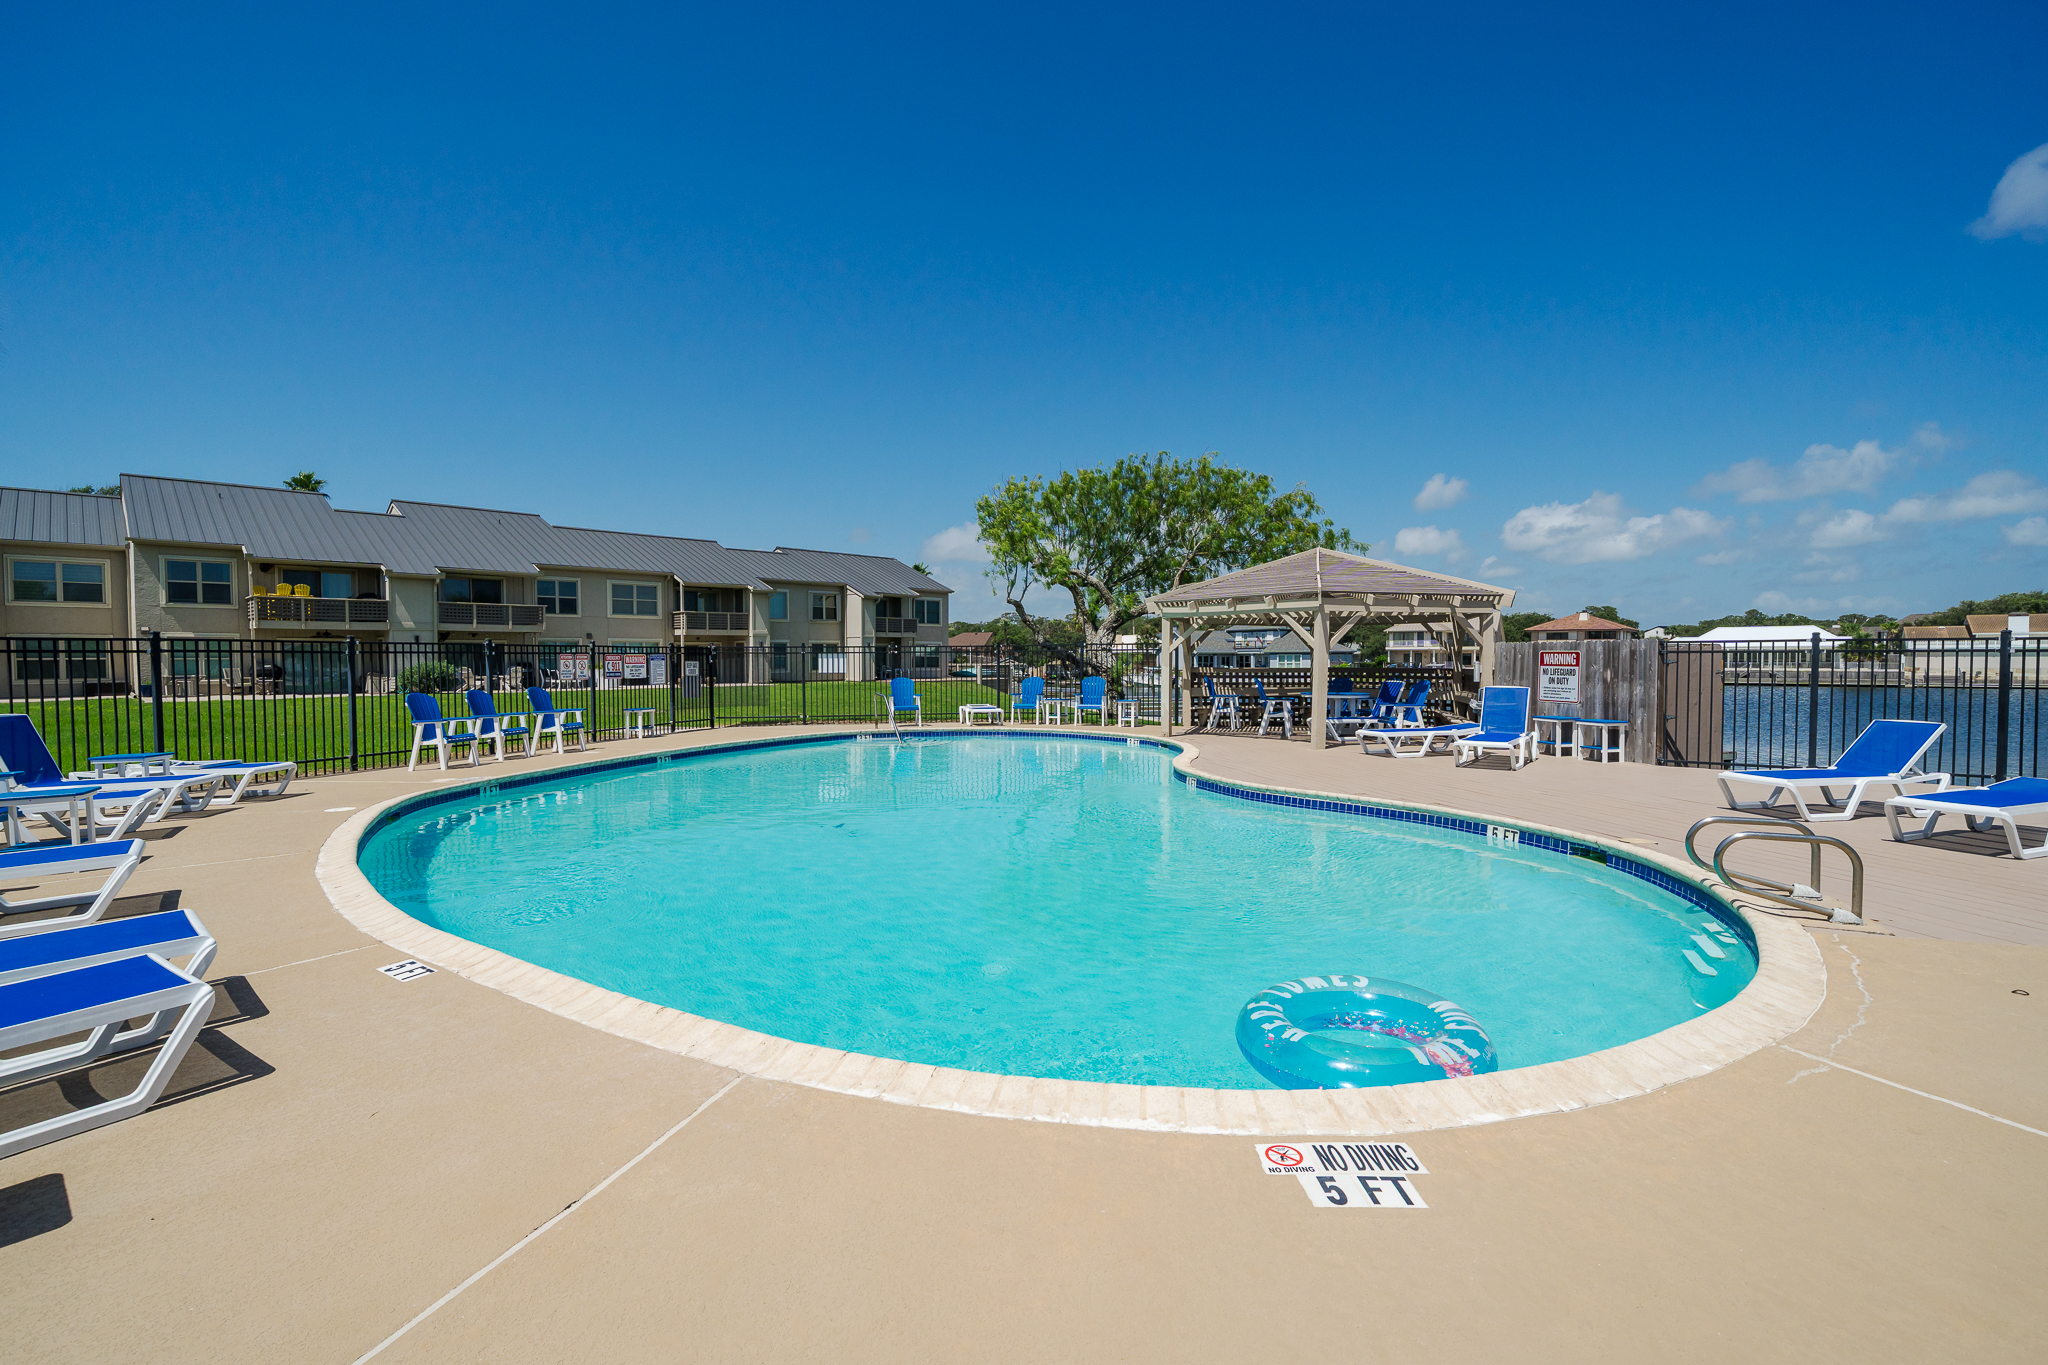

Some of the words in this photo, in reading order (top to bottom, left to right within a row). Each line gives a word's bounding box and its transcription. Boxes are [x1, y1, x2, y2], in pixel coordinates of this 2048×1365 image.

[626, 656, 645, 664] WARNING
[1543, 653, 1577, 665] WARNING
[611, 662, 620, 671] 911
[1542, 668, 1549, 676] NO
[1550, 668, 1577, 676] LIFEGUARD
[1548, 677, 1556, 685] ON
[1556, 677, 1570, 685] DUTY
[1503, 829, 1519, 843] FT
[1312, 1144, 1349, 1171] NO
[1343, 1144, 1420, 1172] DIVING
[1315, 1175, 1348, 1206] 5
[1356, 1175, 1415, 1206] FT
